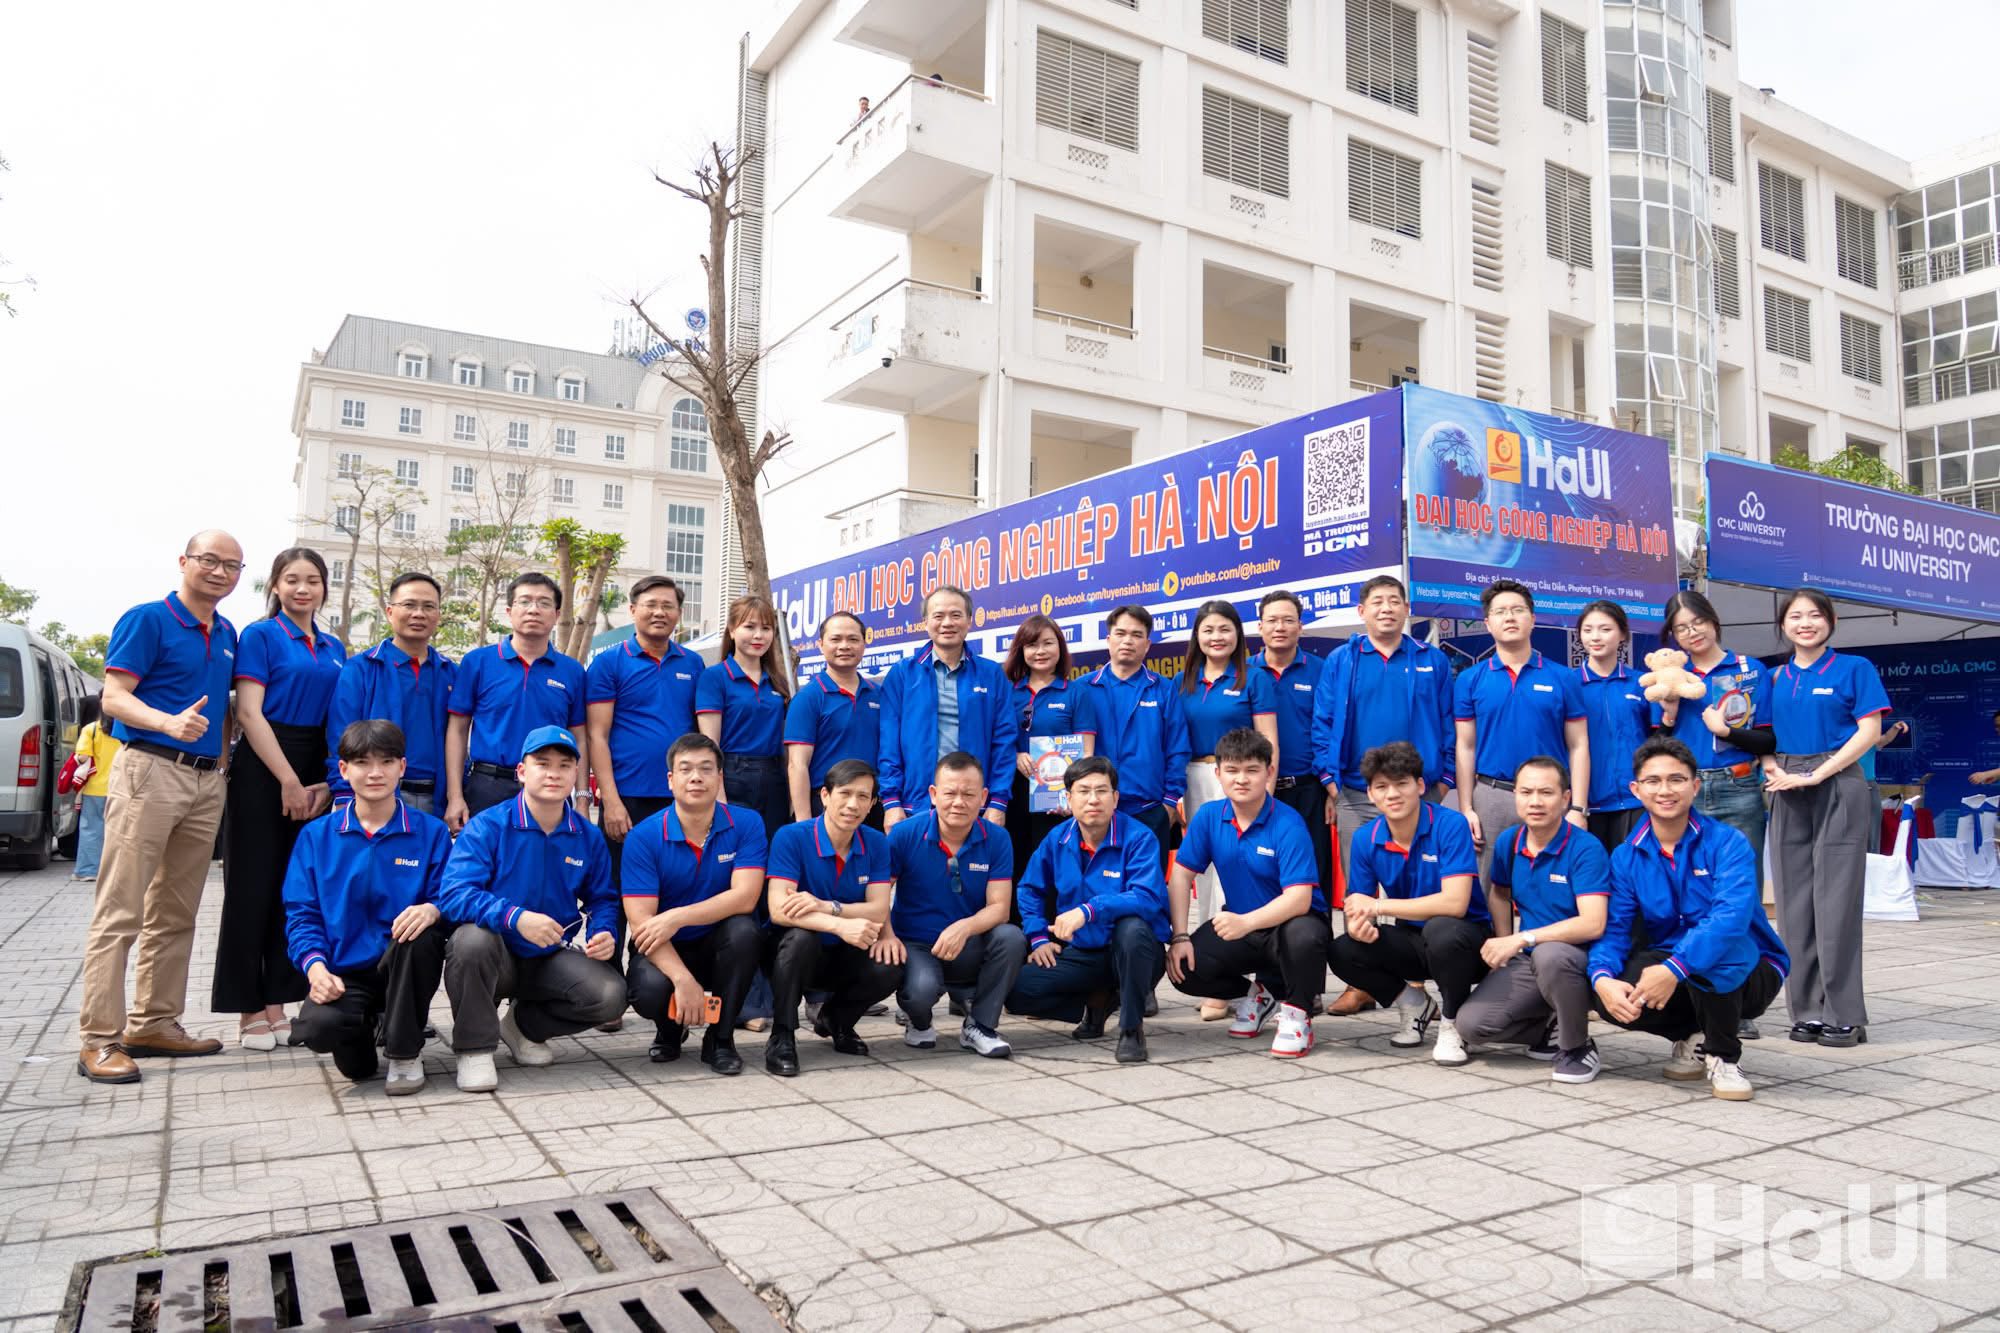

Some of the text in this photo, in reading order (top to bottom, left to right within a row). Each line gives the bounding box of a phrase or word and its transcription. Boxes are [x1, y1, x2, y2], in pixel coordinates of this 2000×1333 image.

[1526, 435, 1612, 500] HaUI
[871, 556, 915, 619] HỌC
[921, 536, 991, 601] CÔNG
[999, 495, 1118, 586] NGHIỆP
[1129, 472, 1185, 558] HÀ
[1197, 449, 1279, 551] NỘI
[1415, 493, 1669, 561] ĐẠI HỌC CÔNG NGHIỆP HÀ NỘI
[1717, 516, 1786, 538] CMC UNIVERSITY
[1825, 502, 2000, 558] TRƯỜNG ĐẠI HỌC CMC
[1304, 531, 1369, 557] DCN
[1180, 557, 1281, 591] youtube.com/@hauitv
[1861, 544, 1877, 568] AI
[1882, 547, 1971, 583] UNIVERSITY
[1054, 579, 1160, 607] facebook.com/tuyensinh.haui
[1314, 591, 1337, 610] Điện
[1340, 585, 1351, 605] tử
[1172, 612, 1178, 629] Ô
[1179, 613, 1188, 628] tô
[1743, 670, 1758, 680] HaUI
[1888, 662, 1910, 677] MỞ
[1913, 664, 1927, 675] AI
[1931, 660, 1960, 674] CỦA
[1964, 661, 1997, 673] CMC
[1062, 735, 1083, 744] HaUI
[402, 858, 419, 867] HaUI
